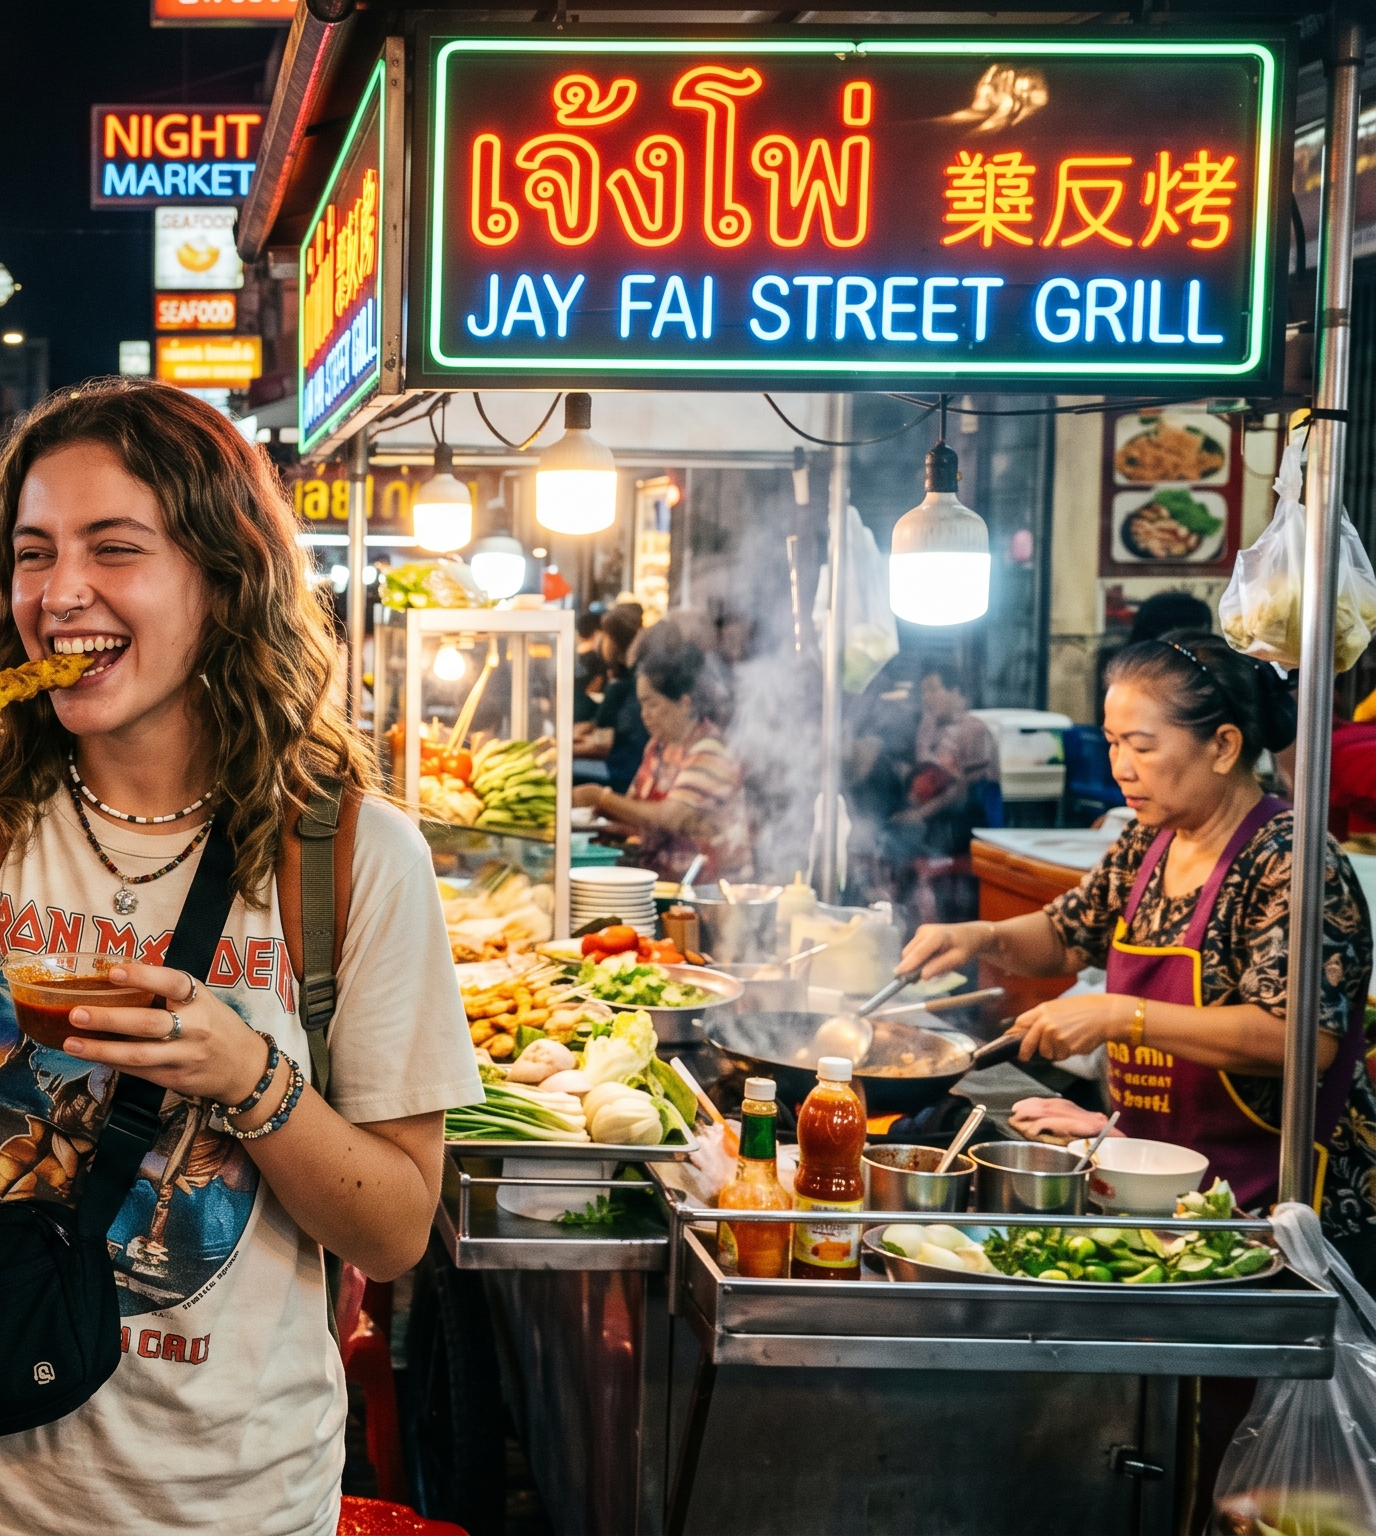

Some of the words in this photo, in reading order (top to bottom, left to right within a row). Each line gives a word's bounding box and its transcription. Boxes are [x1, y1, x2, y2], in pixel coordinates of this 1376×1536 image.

[104, 113, 261, 159] NIGHT
[103, 162, 255, 197] MARKET
[158, 300, 235, 323] SEAFOOD
[466, 272, 585, 338] JAY
[619, 273, 714, 340] FAI
[749, 274, 1005, 343] STREET
[1034, 276, 1224, 345] GRILL
